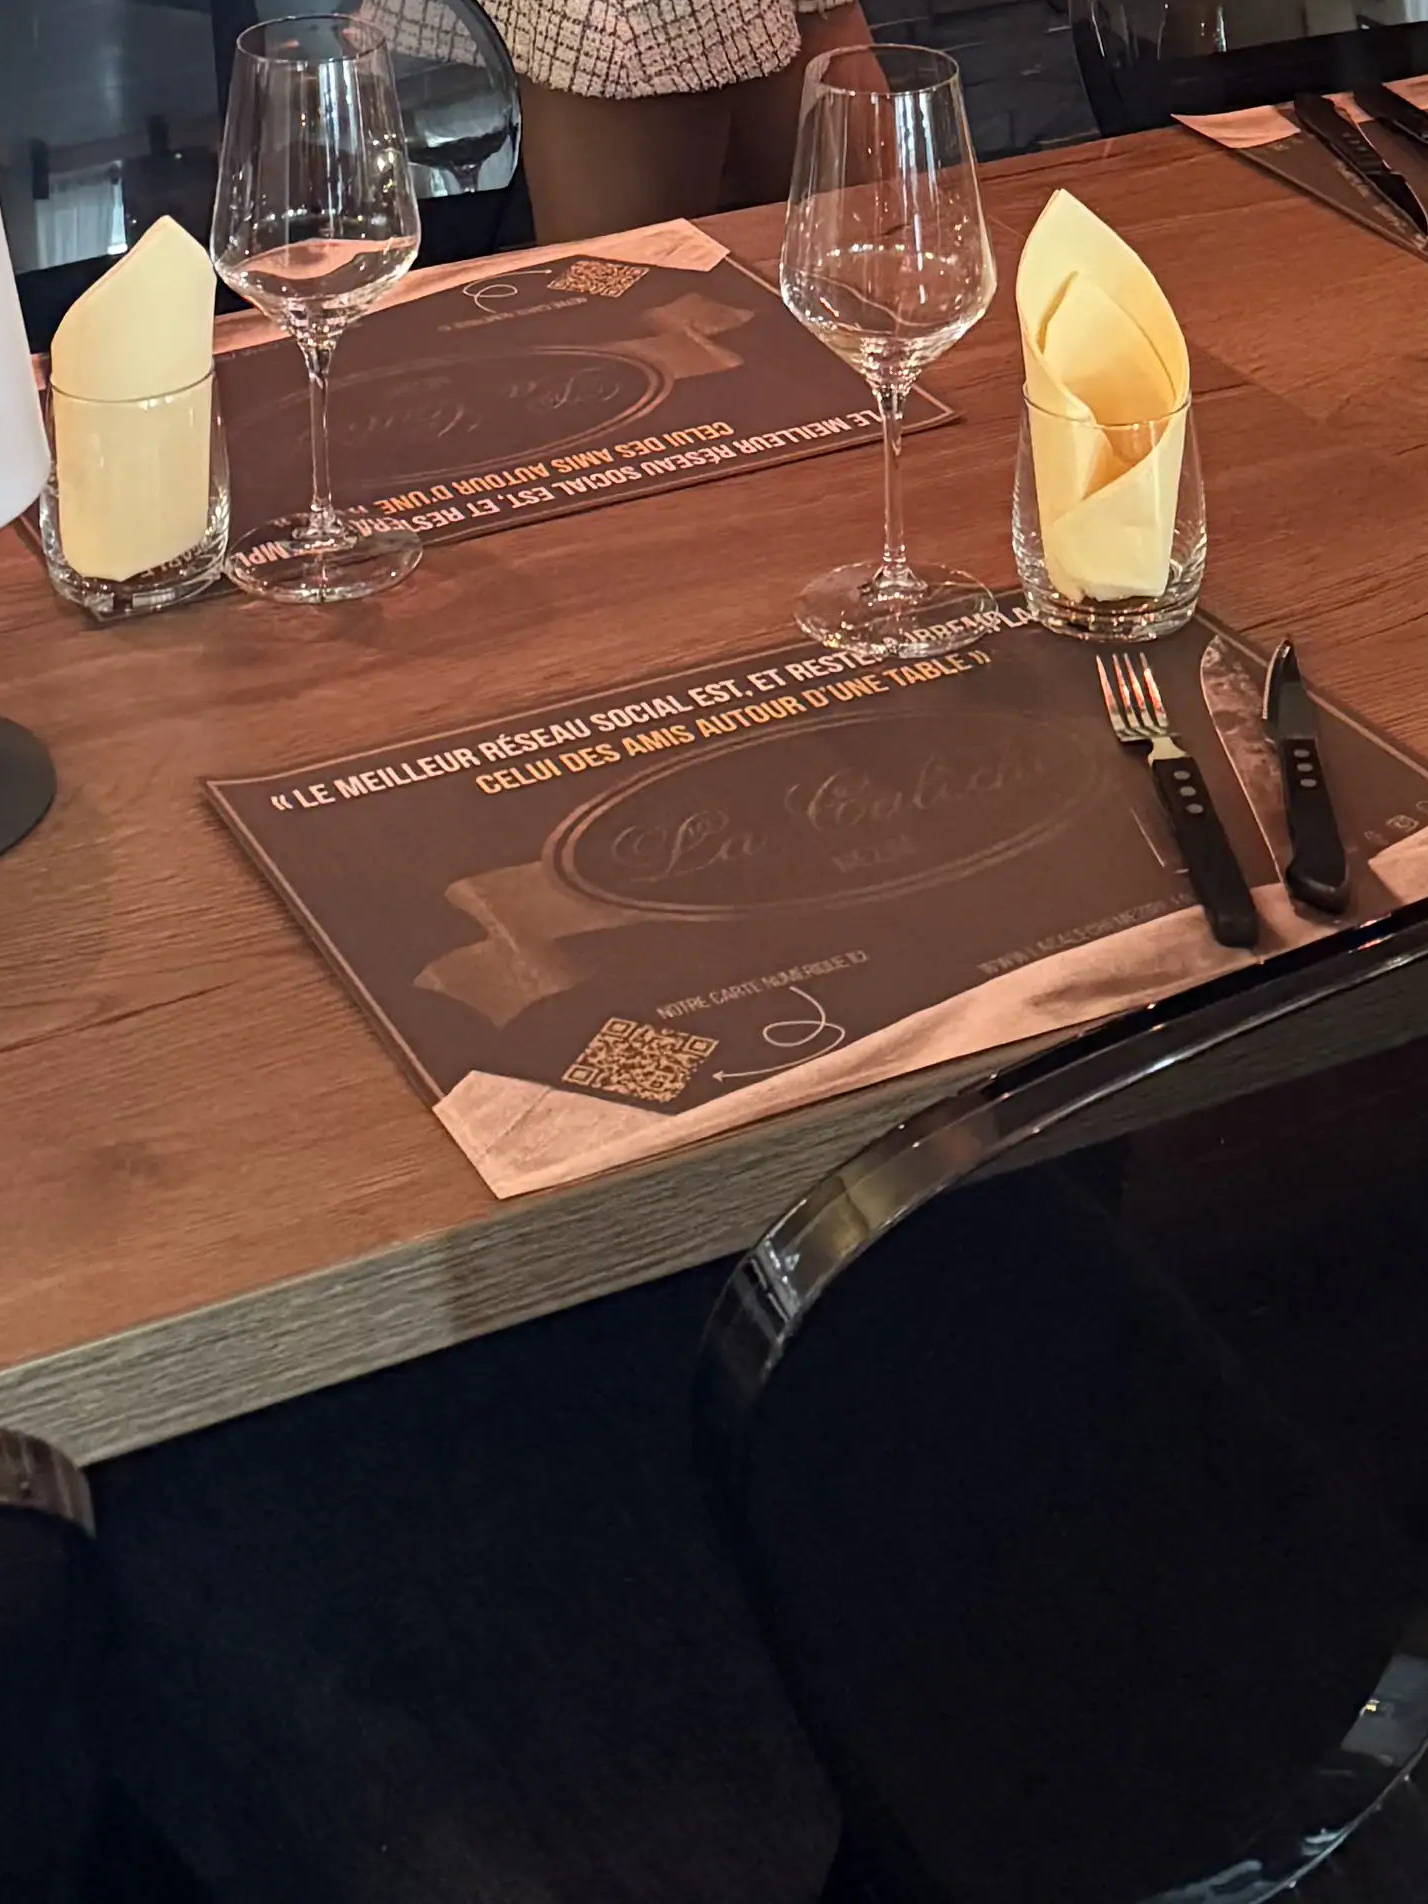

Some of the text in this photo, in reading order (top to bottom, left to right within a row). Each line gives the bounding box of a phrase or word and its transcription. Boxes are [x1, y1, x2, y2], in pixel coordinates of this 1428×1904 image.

[620, 435, 668, 459] DES
[666, 421, 735, 447] CELUI
[731, 415, 852, 455] MEILLEUR
[555, 447, 615, 473] AMIS
[644, 443, 737, 477] RÉSEAU
[449, 462, 548, 496] AUTOUR
[552, 463, 642, 497] SOCIAL
[374, 487, 451, 515] D'UNE
[467, 497, 502, 518] ET
[498, 484, 556, 509] EST,
[475, 756, 563, 795] CELUI
[558, 743, 622, 774] DES
[624, 723, 696, 757] AMIS
[696, 694, 808, 739] AUTOUR
[799, 673, 890, 710] D'UNE
[882, 654, 973, 690] TABLE
[292, 783, 336, 810] LE
[334, 747, 481, 799] MEILLEUR
[477, 717, 592, 762] RÉSEAU
[588, 691, 696, 733] SOCIAL
[688, 678, 754, 709] EST,
[748, 668, 789, 696] ET
[656, 995, 710, 1020] NOTRE
